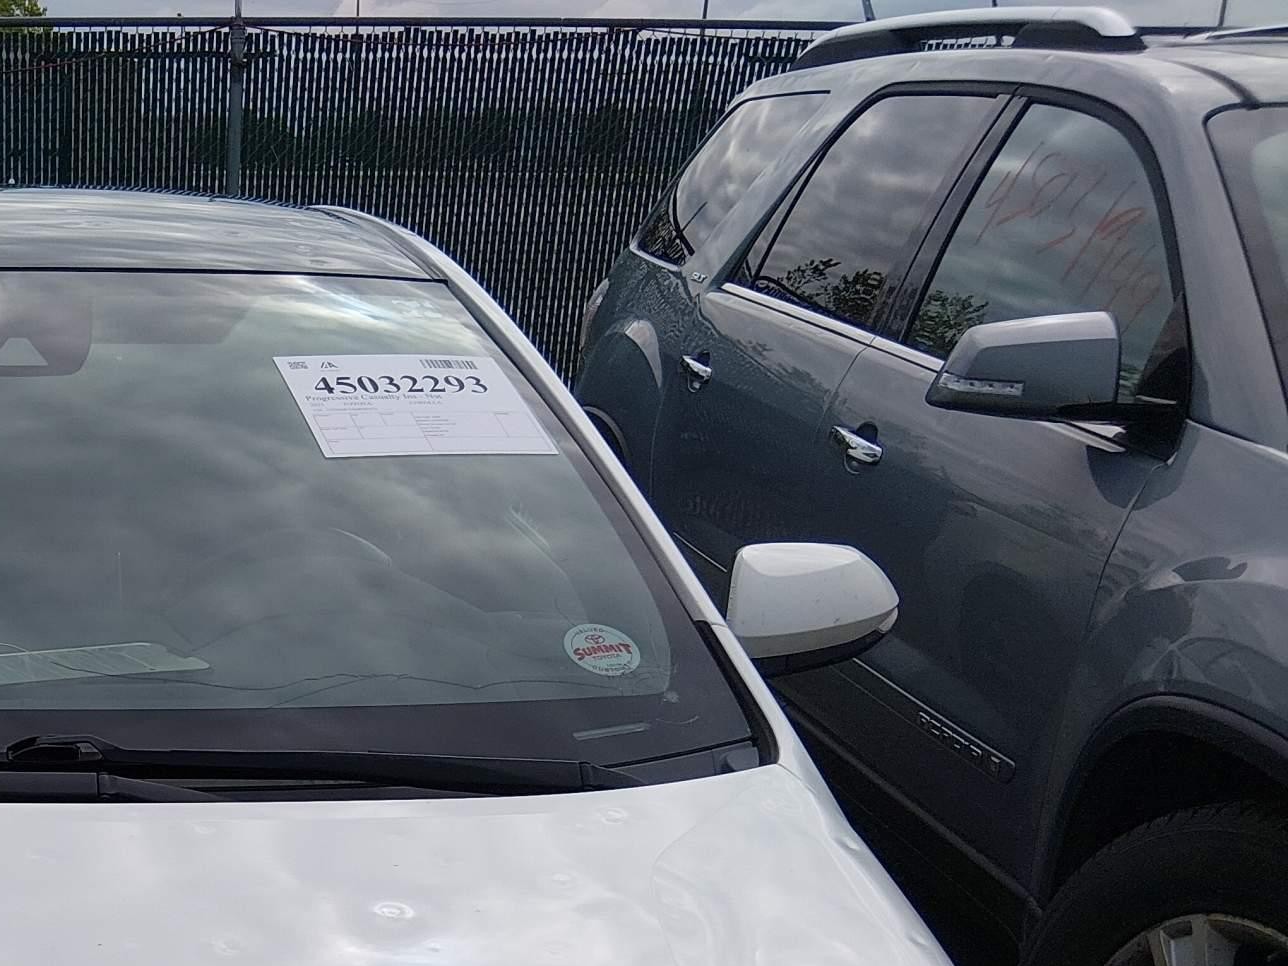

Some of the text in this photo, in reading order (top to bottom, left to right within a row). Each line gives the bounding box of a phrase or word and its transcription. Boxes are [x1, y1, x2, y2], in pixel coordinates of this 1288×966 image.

[314, 375, 488, 394] 45032293
[305, 394, 359, 402] Progressive
[573, 642, 632, 660] SUMMIT
